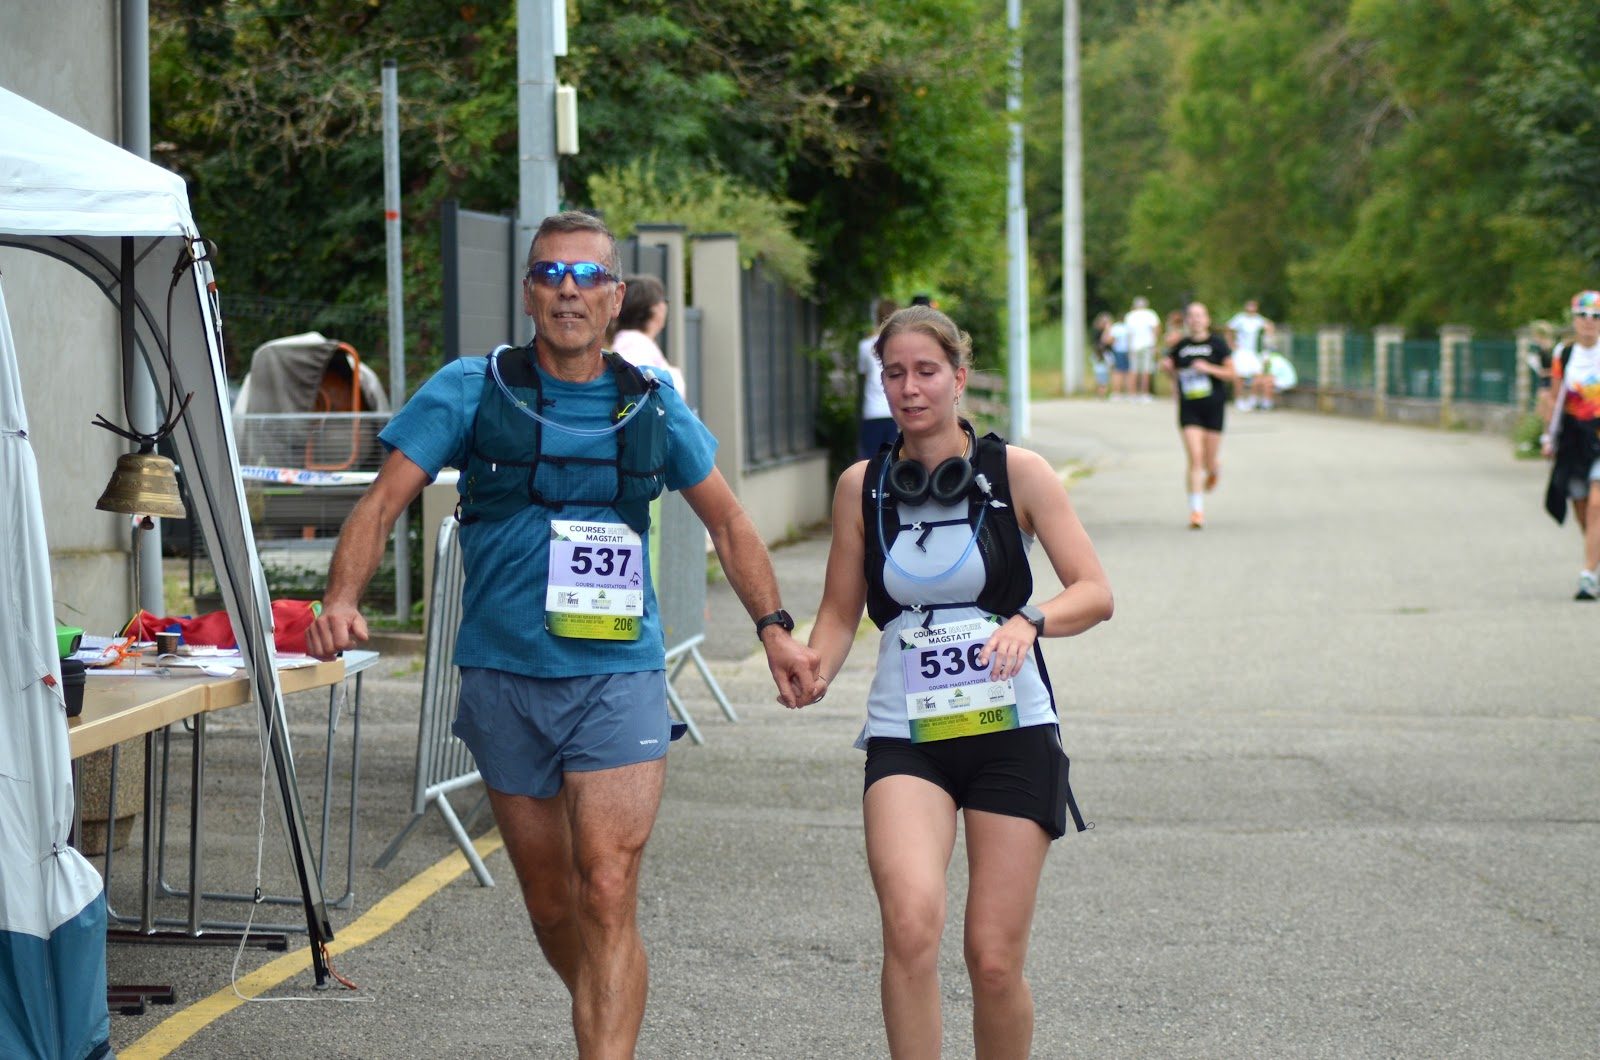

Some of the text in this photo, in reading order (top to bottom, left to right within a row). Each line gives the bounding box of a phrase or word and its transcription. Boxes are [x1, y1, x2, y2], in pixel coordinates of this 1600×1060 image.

[569, 525, 606, 534] COURSES
[585, 534, 624, 543] MAGSTATT
[570, 546, 632, 577] 537
[613, 617, 633, 631] 20€
[913, 627, 947, 639] COURSES
[928, 632, 972, 645] MAGSTATT
[920, 643, 990, 679] 536
[928, 683, 949, 691] COURSE
[978, 708, 1004, 725] 20€
